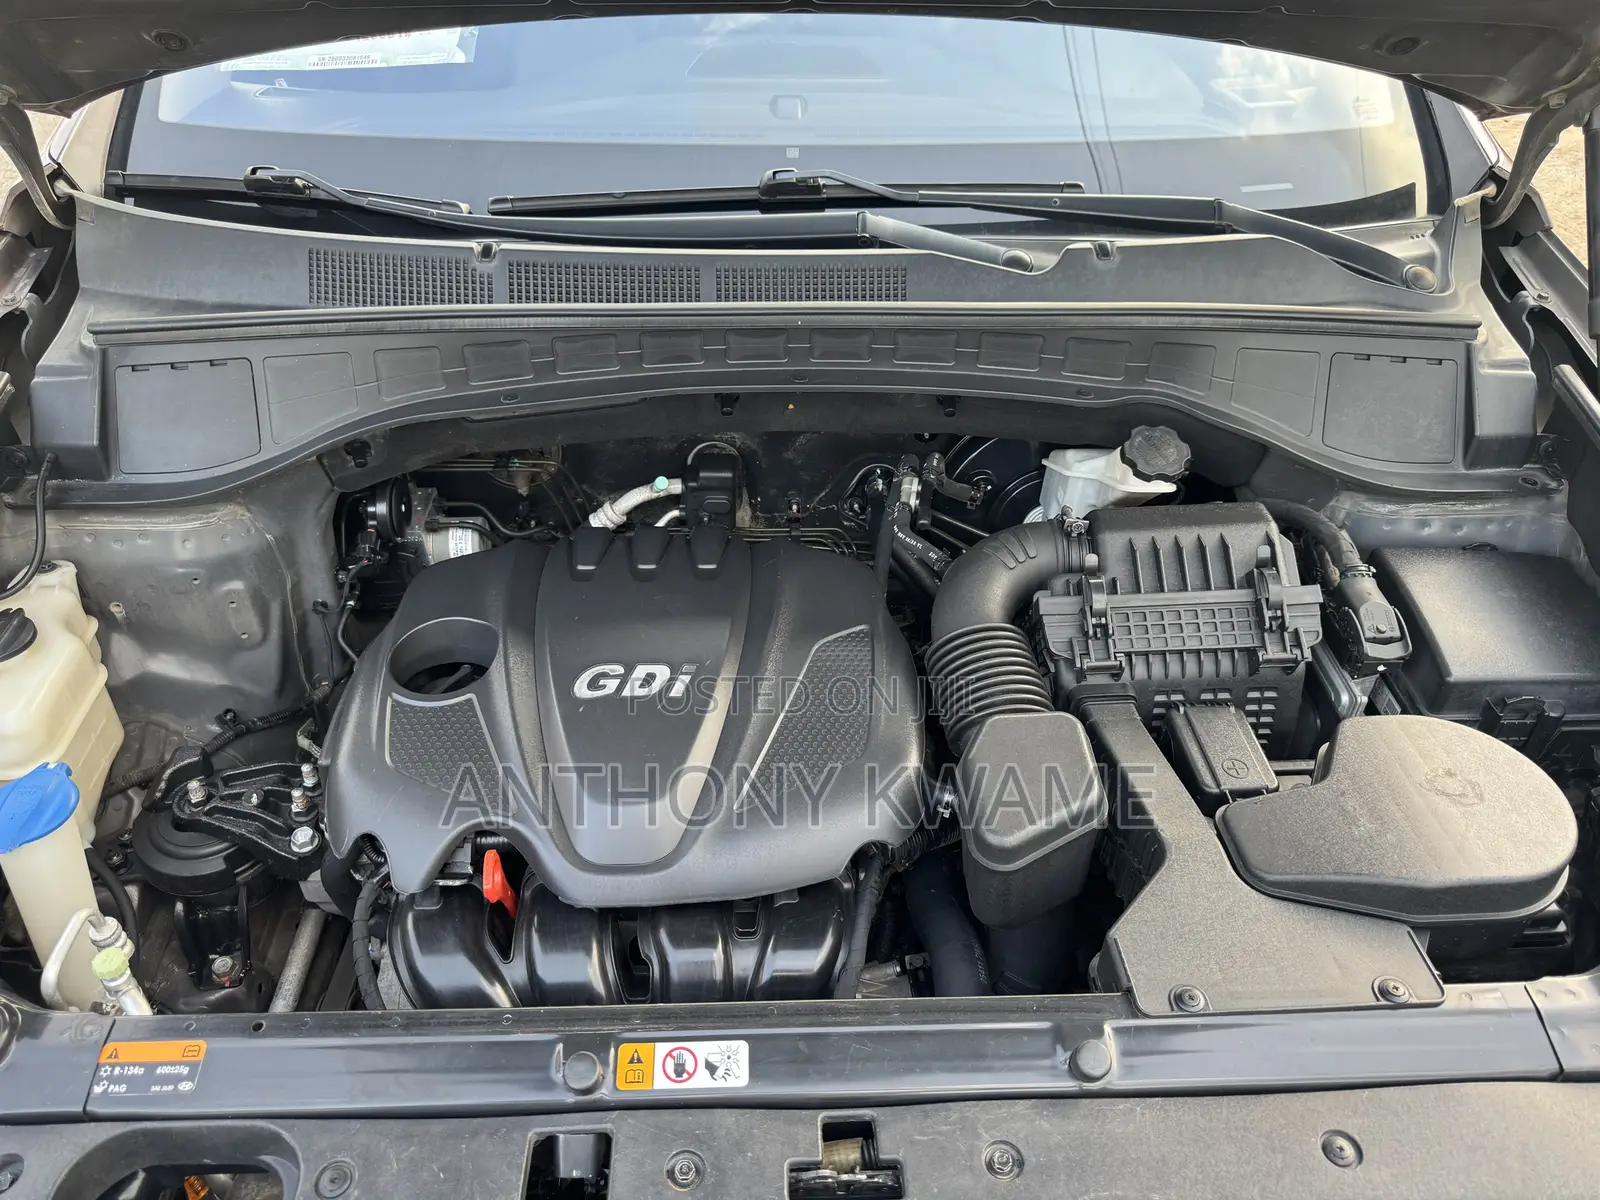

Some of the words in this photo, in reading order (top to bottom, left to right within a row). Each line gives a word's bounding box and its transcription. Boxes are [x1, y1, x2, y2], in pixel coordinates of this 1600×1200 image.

[572, 663, 697, 698] GDi
[113, 1065, 145, 1075] R-134a
[107, 1084, 128, 1093] PAG
